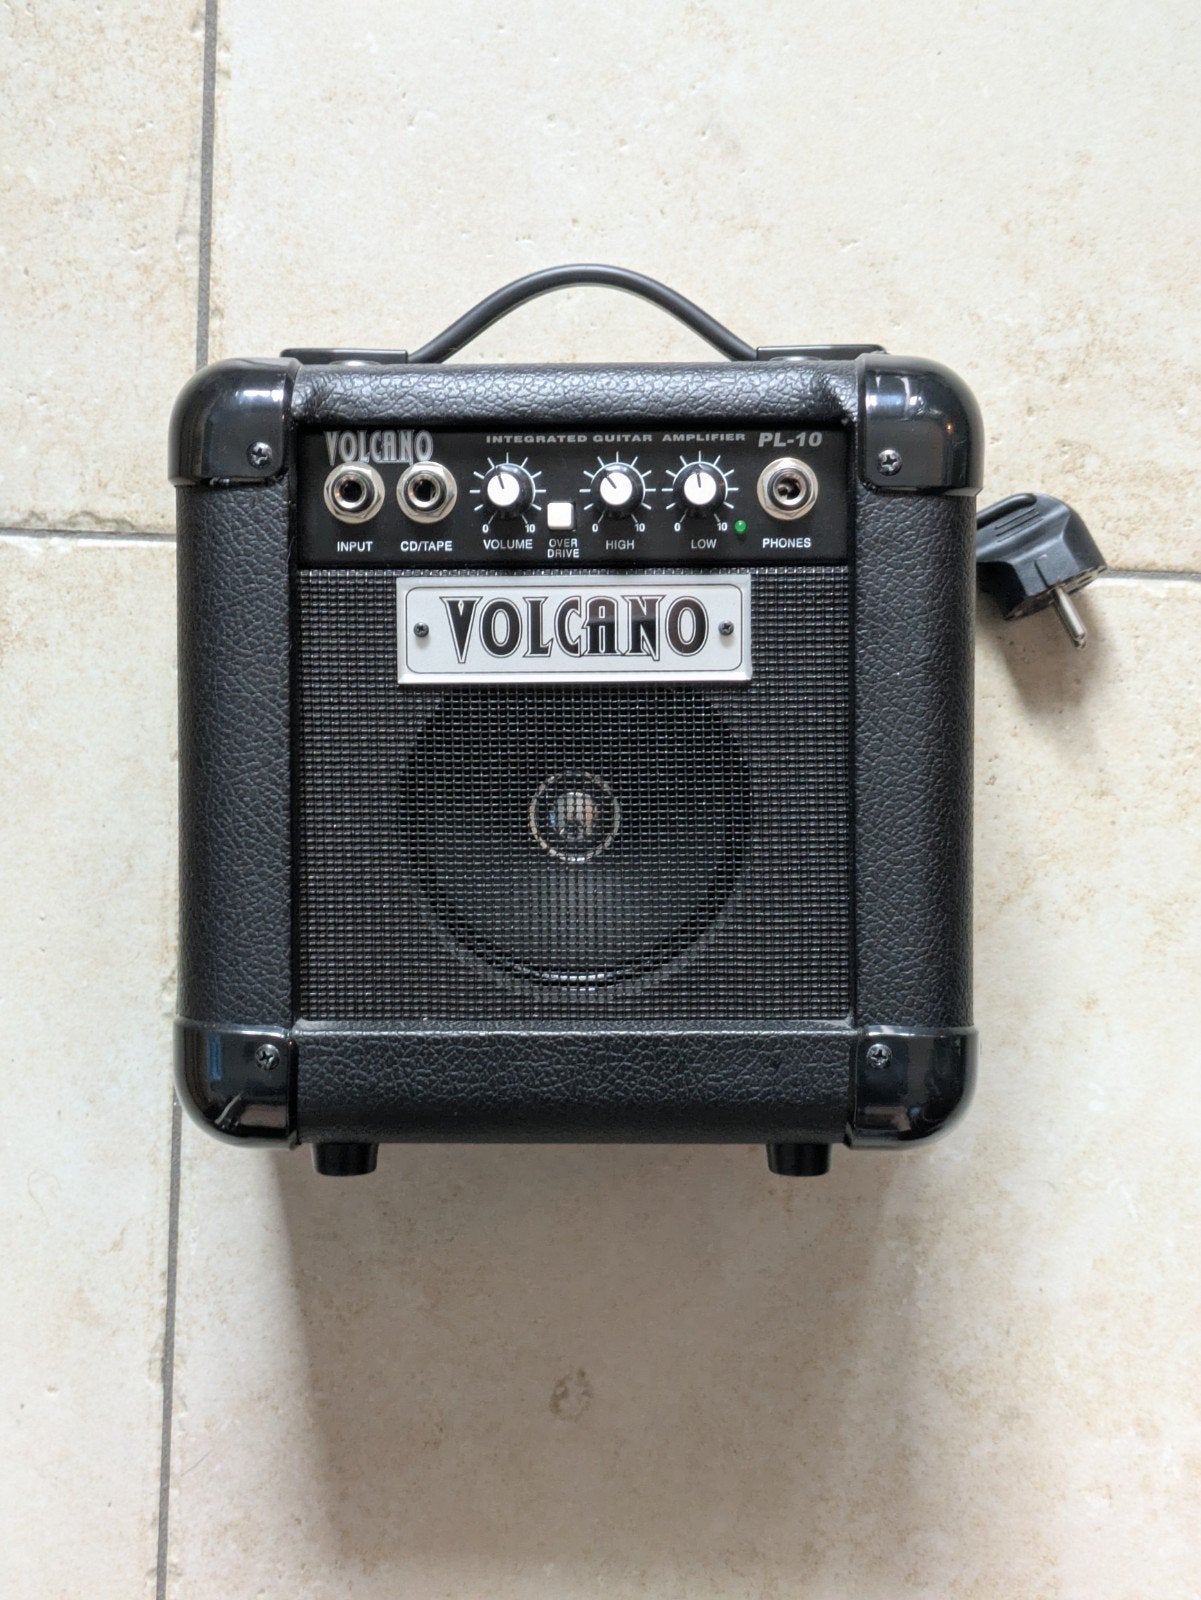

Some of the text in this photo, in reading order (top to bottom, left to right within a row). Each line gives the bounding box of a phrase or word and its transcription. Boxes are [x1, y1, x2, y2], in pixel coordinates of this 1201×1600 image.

[486, 433, 746, 444] INTEGRATED GUITAR AMPLIFIER
[758, 431, 823, 447] PL-10
[323, 429, 433, 466] VOLCANO
[482, 524, 489, 533] 0
[525, 524, 536, 533] 10
[592, 523, 599, 533] 0
[635, 523, 646, 532] 10
[674, 523, 681, 532] 0
[717, 522, 728, 531] 10
[337, 541, 373, 552] INPUT
[400, 540, 453, 551] CD/TAPE
[483, 539, 533, 549] VOLUME
[549, 538, 578, 548] OVER
[605, 540, 635, 550] HIGH
[691, 539, 717, 549] LOW
[762, 538, 812, 548] PHONES
[547, 549, 580, 558] DRIVE
[439, 594, 709, 664] VOLCANO
